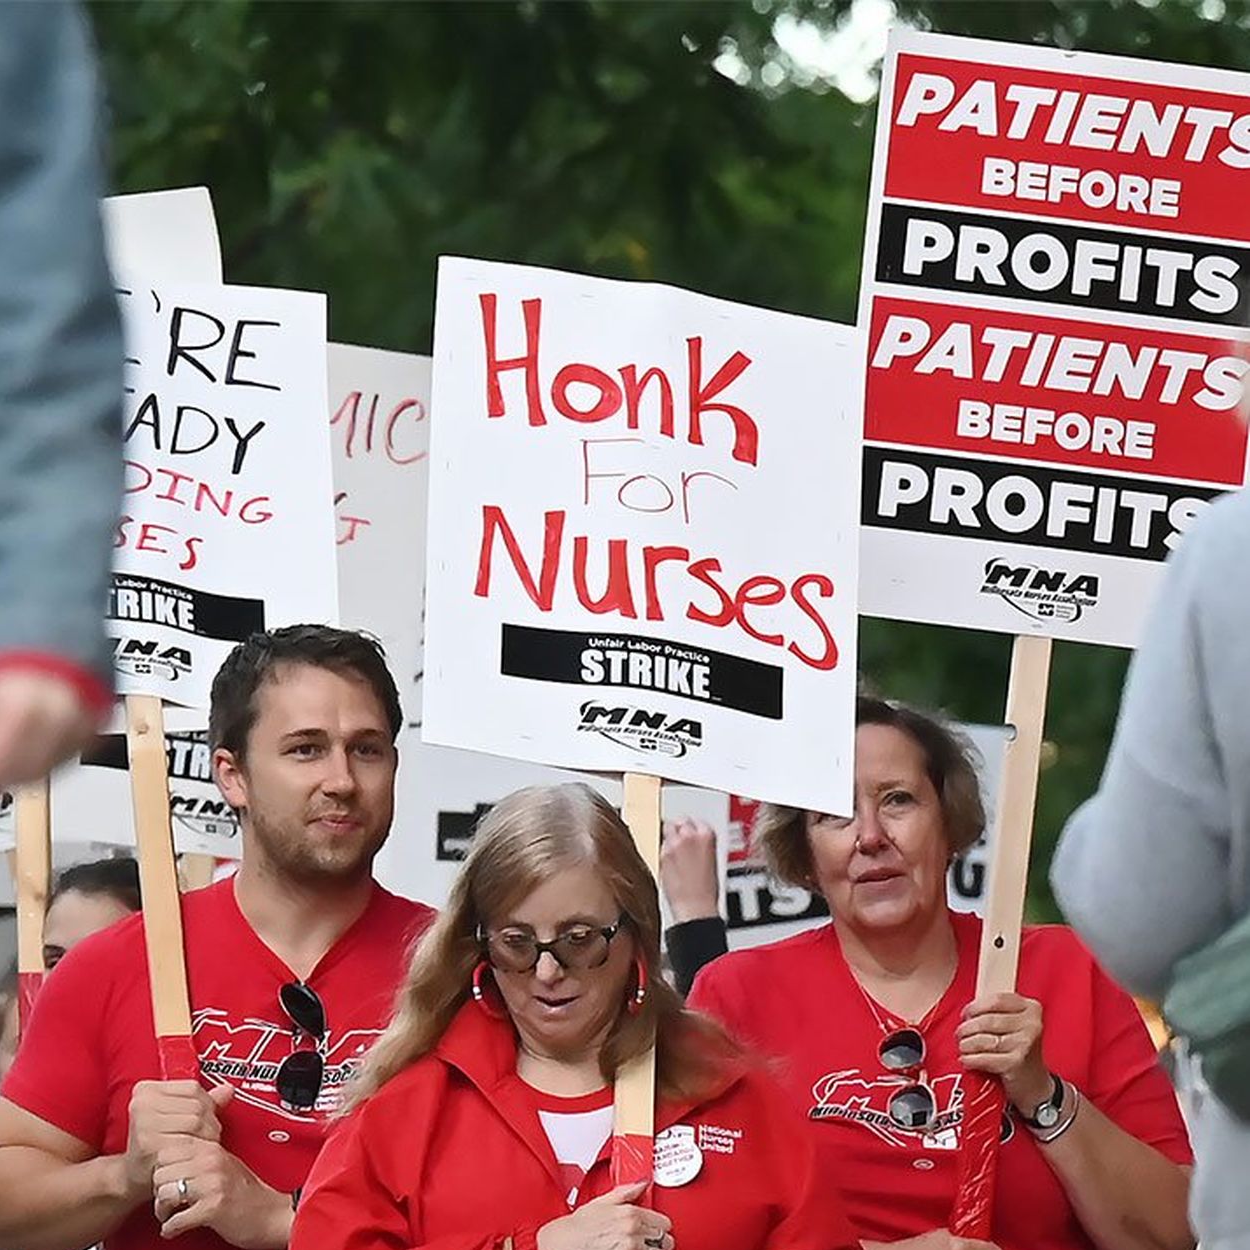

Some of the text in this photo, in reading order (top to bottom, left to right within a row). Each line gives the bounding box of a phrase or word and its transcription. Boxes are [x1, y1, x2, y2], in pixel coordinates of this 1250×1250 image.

[895, 71, 1250, 170] PATIENTS
[980, 157, 1180, 218] BEFORE
[902, 218, 1240, 315] PROFITS
[479, 292, 759, 466] Honk
[871, 314, 1250, 412] PATIENTS
[956, 400, 1156, 460] BEFORE
[580, 438, 738, 524] For
[474, 505, 838, 671] Nurses
[985, 564, 1099, 597] MNA
[580, 649, 711, 699] STRIKE
[588, 638, 710, 663] Unfair Labor Practice
[581, 705, 702, 739] MNA
